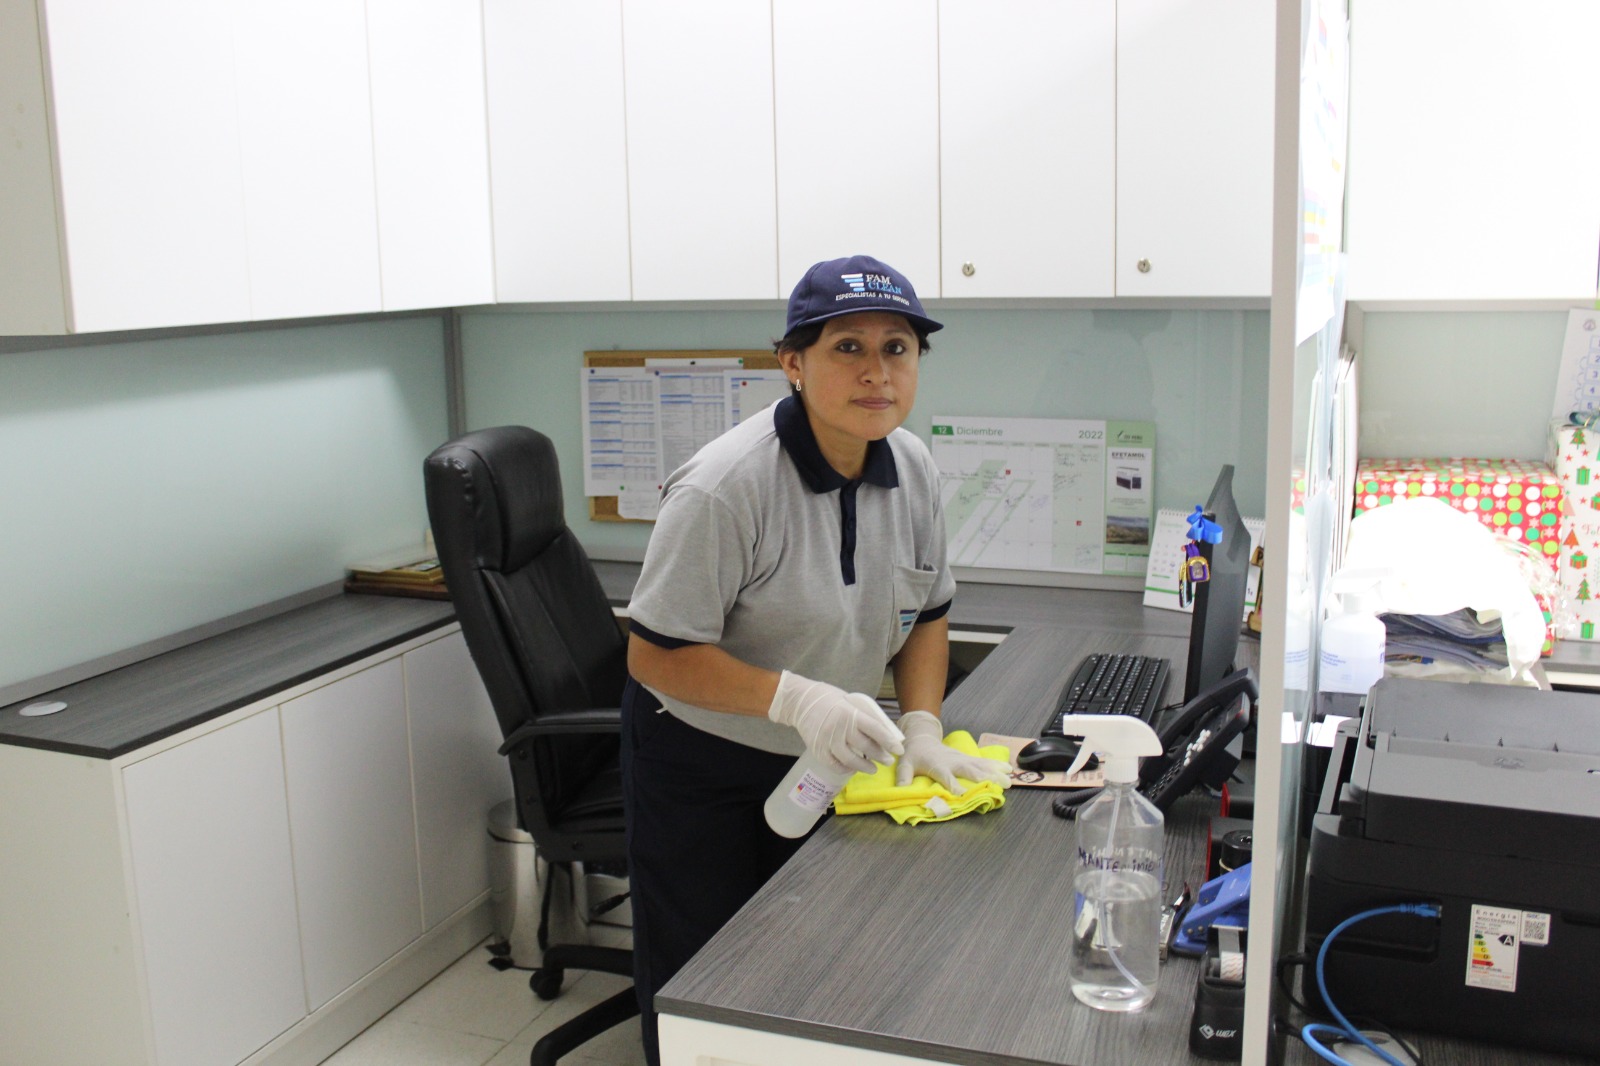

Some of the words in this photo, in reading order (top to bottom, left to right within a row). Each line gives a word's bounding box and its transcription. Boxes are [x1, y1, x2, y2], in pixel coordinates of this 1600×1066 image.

[868, 281, 902, 294] CLEAN
[835, 292, 876, 301] ESPECIALISTAS
[956, 426, 1003, 436] Diciembre
[1078, 430, 1103, 439] 2022
[1503, 935, 1514, 947] A
